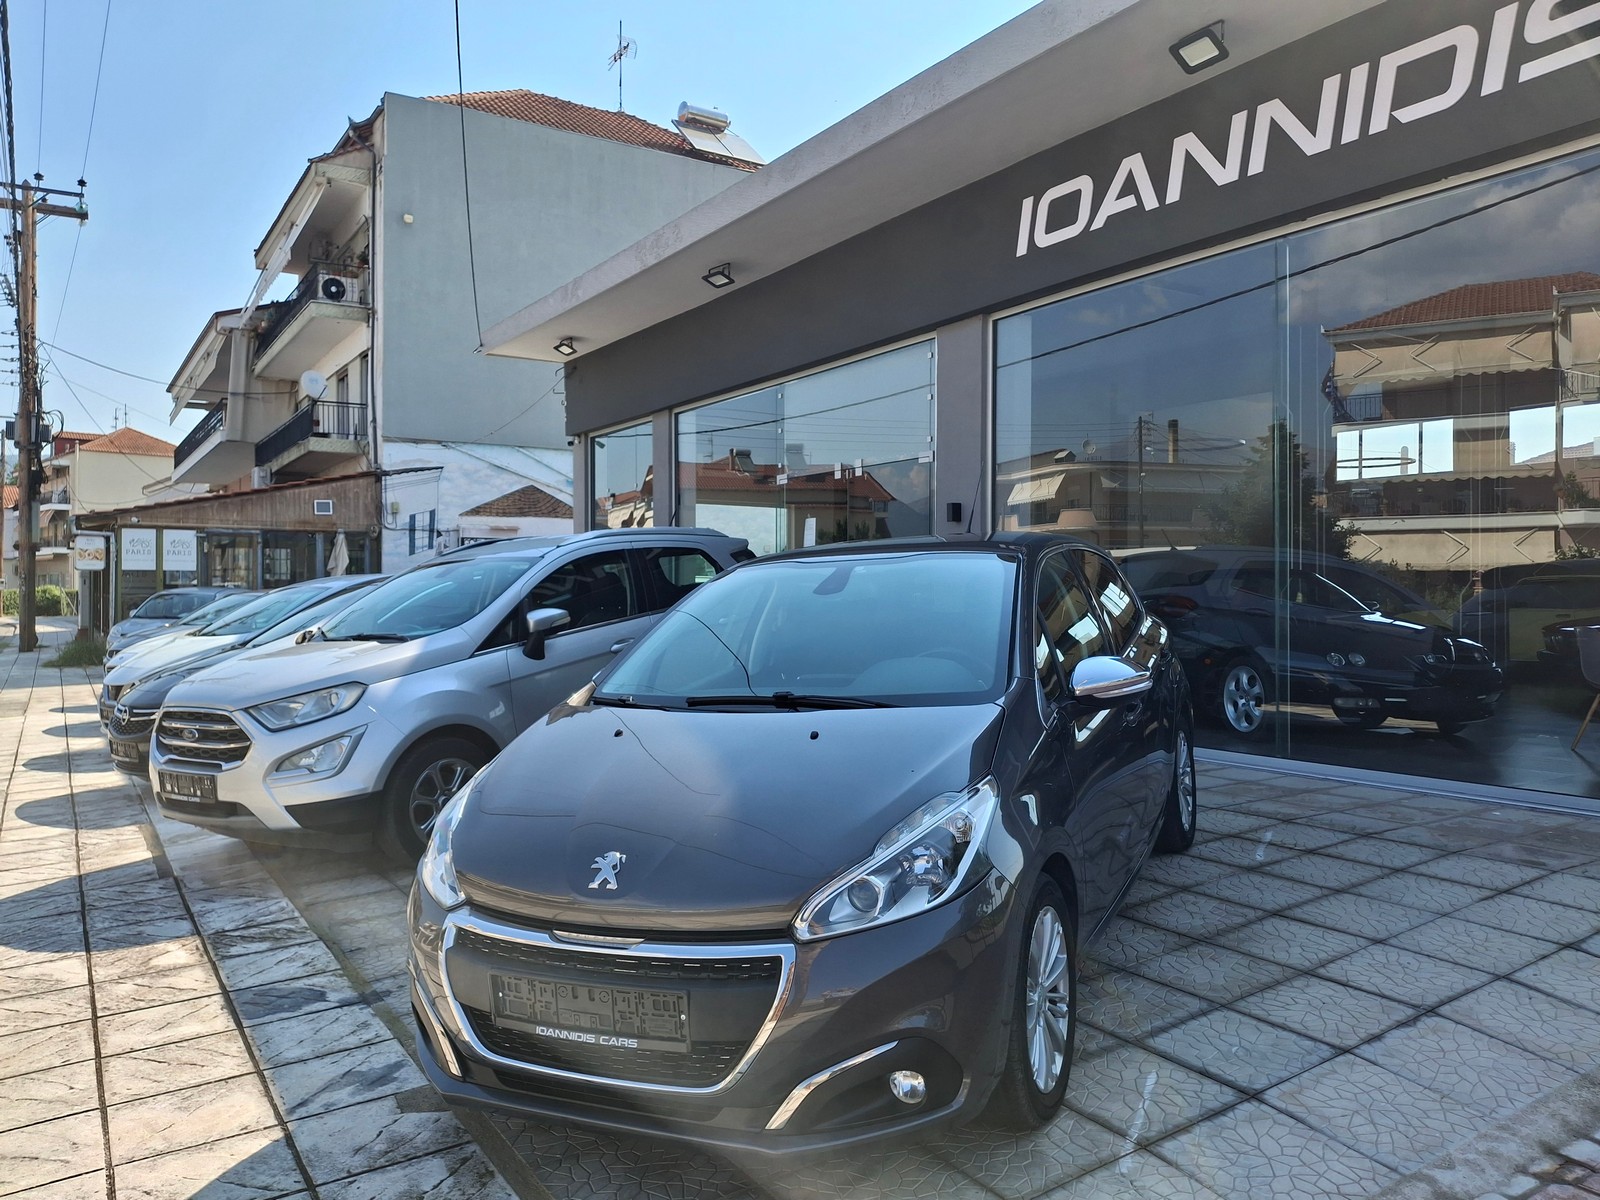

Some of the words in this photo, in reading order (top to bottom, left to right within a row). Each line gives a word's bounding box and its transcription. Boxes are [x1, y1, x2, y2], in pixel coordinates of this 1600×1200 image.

[1015, 0, 1600, 257] IOANNIDIS
[535, 1026, 596, 1043] IOANNIDIS
[599, 1036, 638, 1048] CARS
